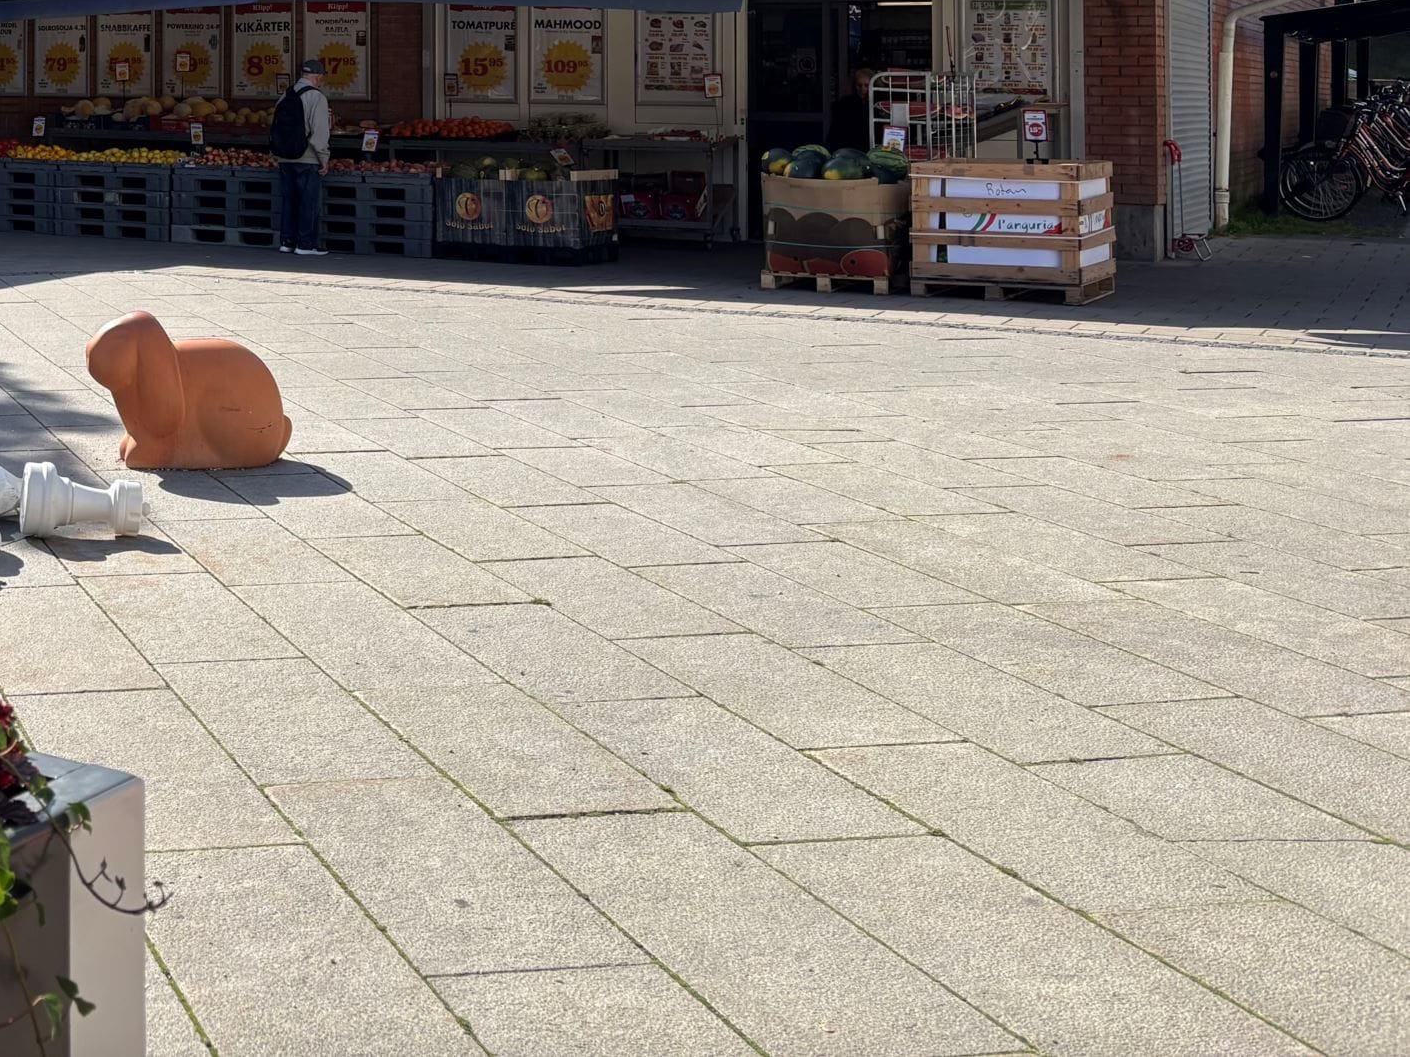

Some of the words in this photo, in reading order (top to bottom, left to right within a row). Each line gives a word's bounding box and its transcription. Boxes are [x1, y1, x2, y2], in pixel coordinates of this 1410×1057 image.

[235, 19, 291, 33] KIKÄRTER
[534, 19, 602, 30] MAHMOOD
[998, 219, 1054, 234] l'anguria
